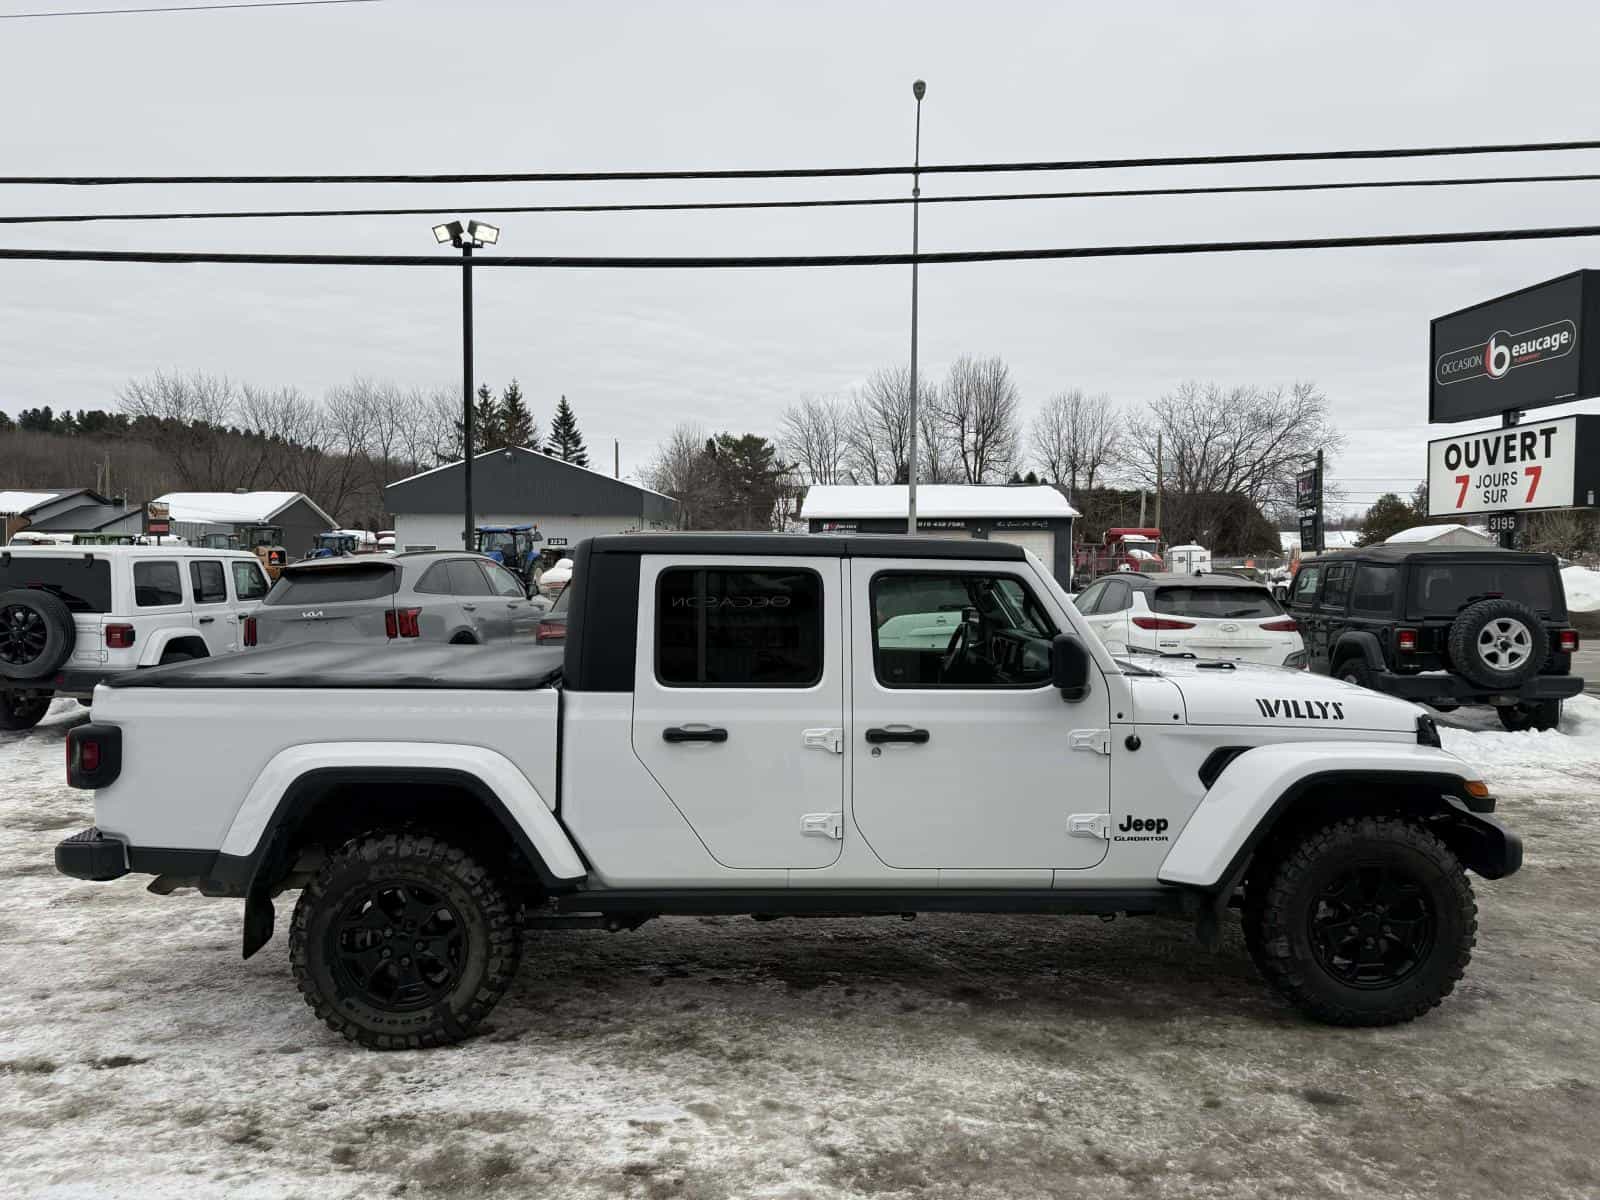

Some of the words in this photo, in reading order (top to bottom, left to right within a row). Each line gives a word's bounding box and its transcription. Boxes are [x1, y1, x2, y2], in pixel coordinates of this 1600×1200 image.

[1441, 354, 1482, 376] OCCASION
[1444, 427, 1557, 471] OUVERT
[1455, 475, 1470, 509] 7
[1475, 471, 1518, 489] JOURS
[1524, 466, 1543, 503] 7
[1483, 488, 1508, 504] SUR
[1255, 698, 1345, 720] WILLYS
[1119, 815, 1169, 834] Jeep
